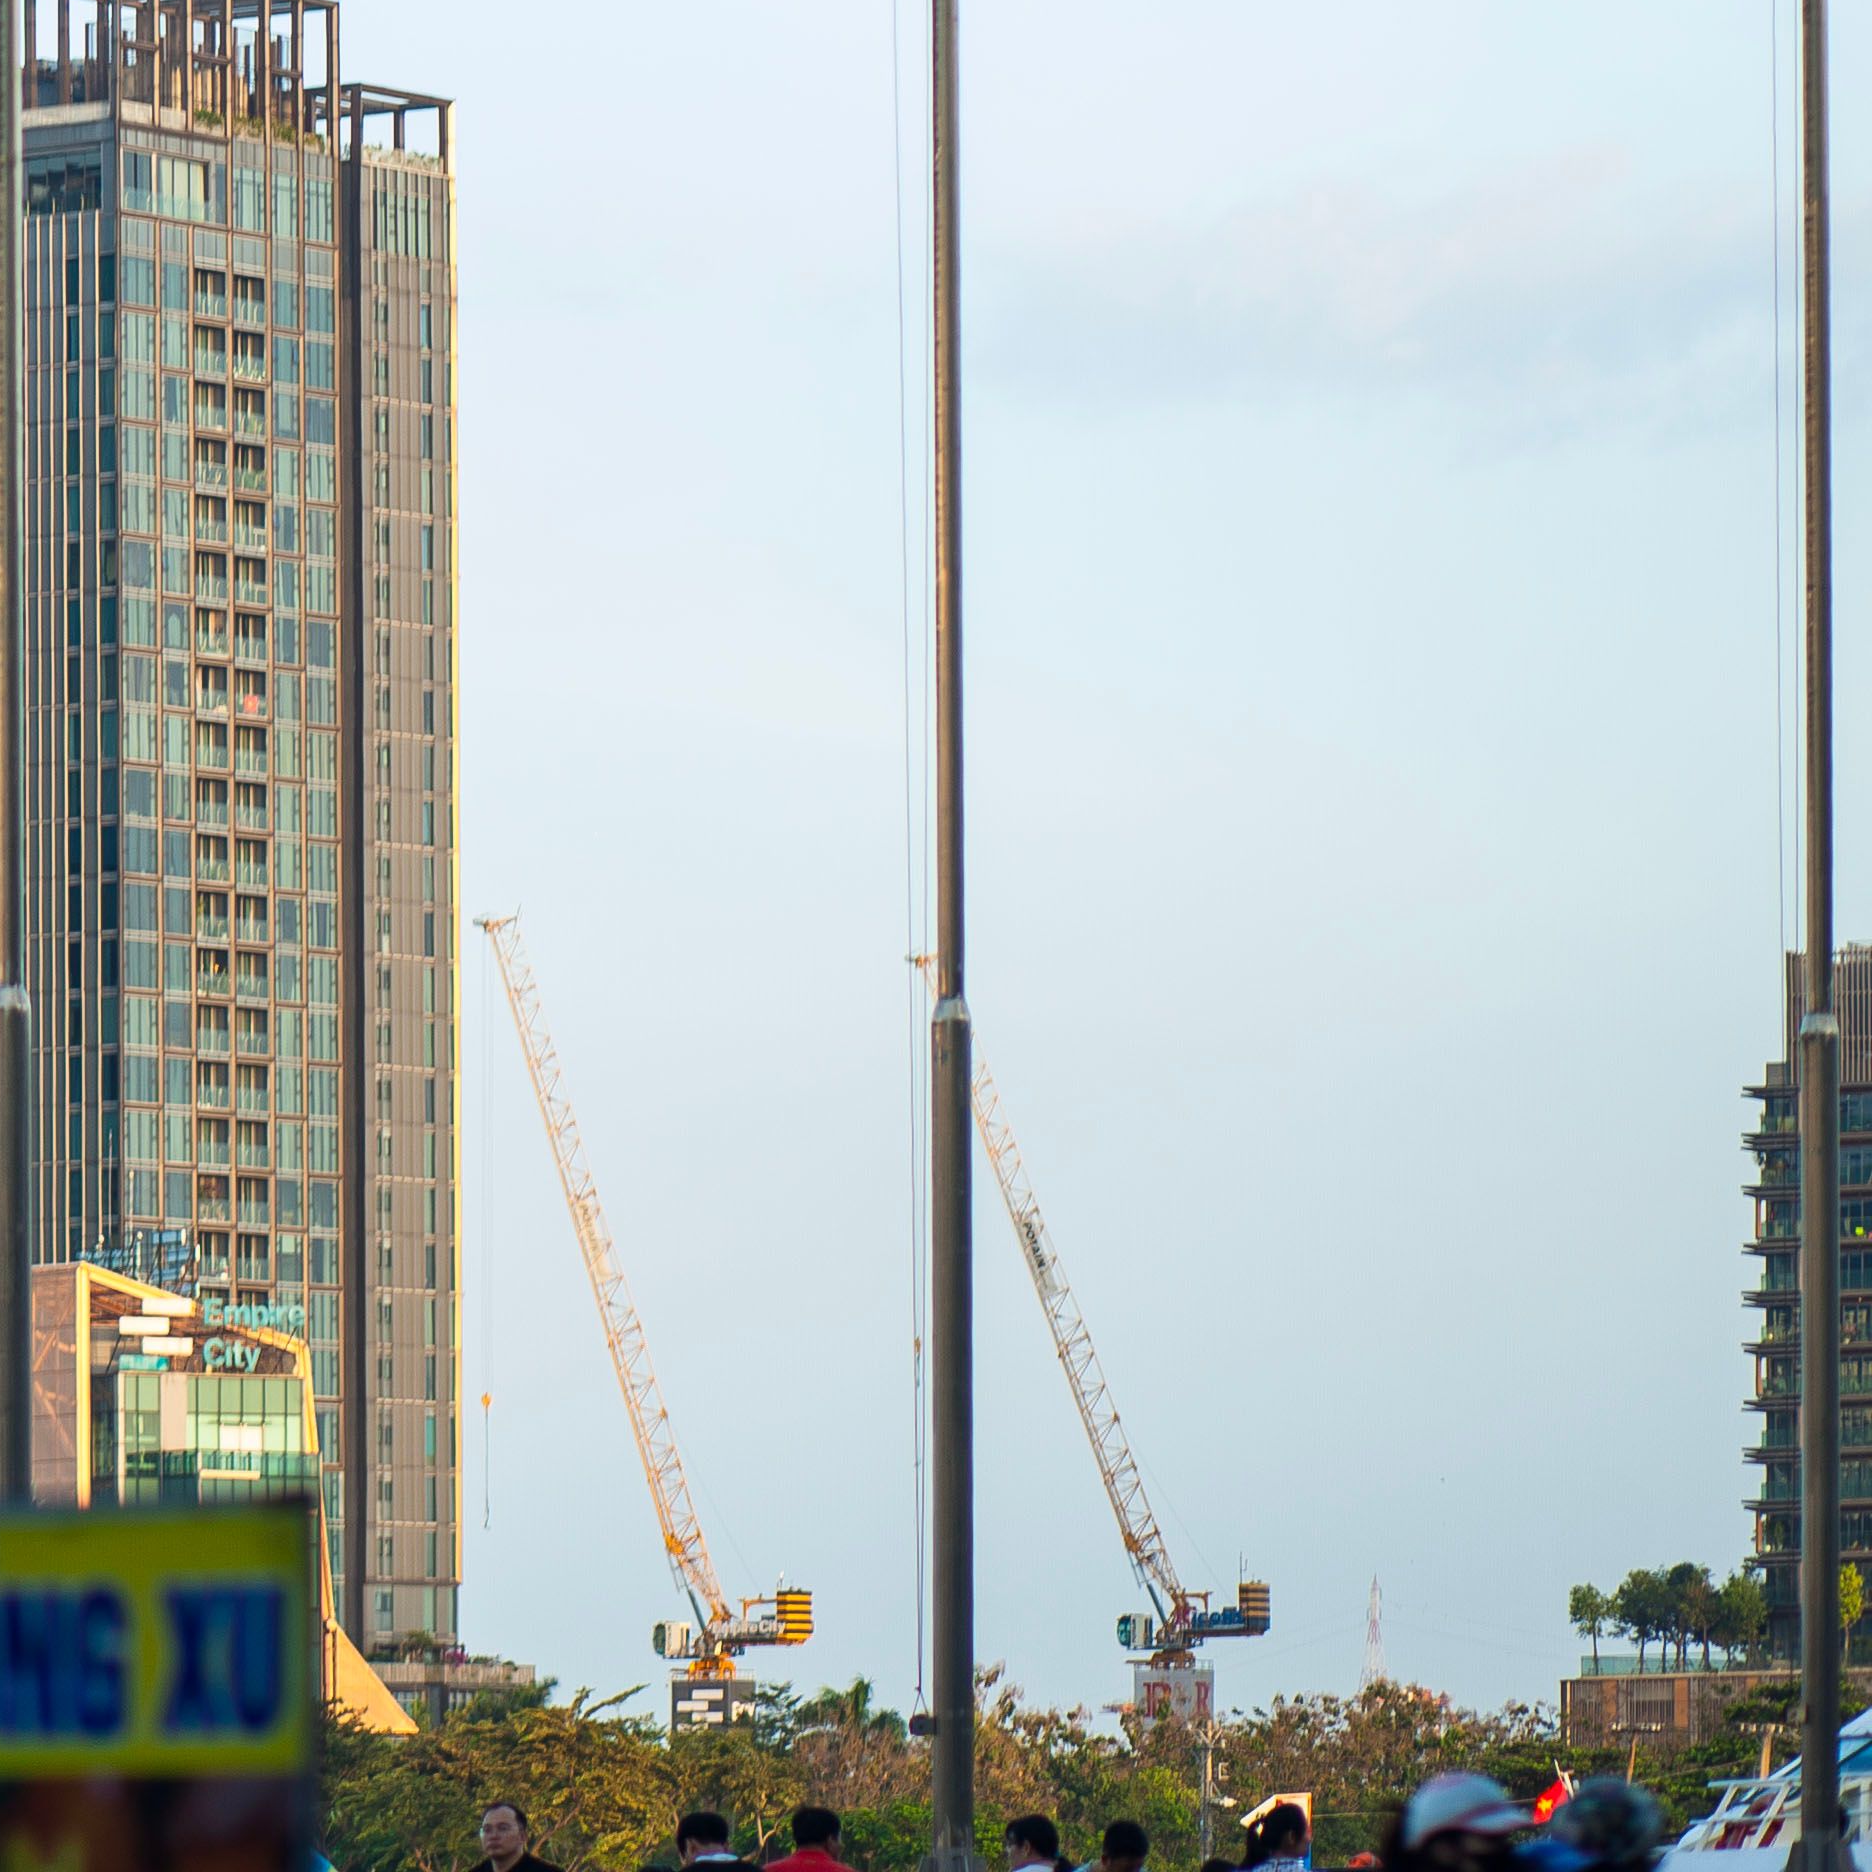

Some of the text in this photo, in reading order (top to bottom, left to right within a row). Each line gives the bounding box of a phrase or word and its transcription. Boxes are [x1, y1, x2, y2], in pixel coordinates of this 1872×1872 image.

[203, 1298, 305, 1332] Empire
[203, 1337, 261, 1373] City
[164, 1581, 284, 1739] XU
